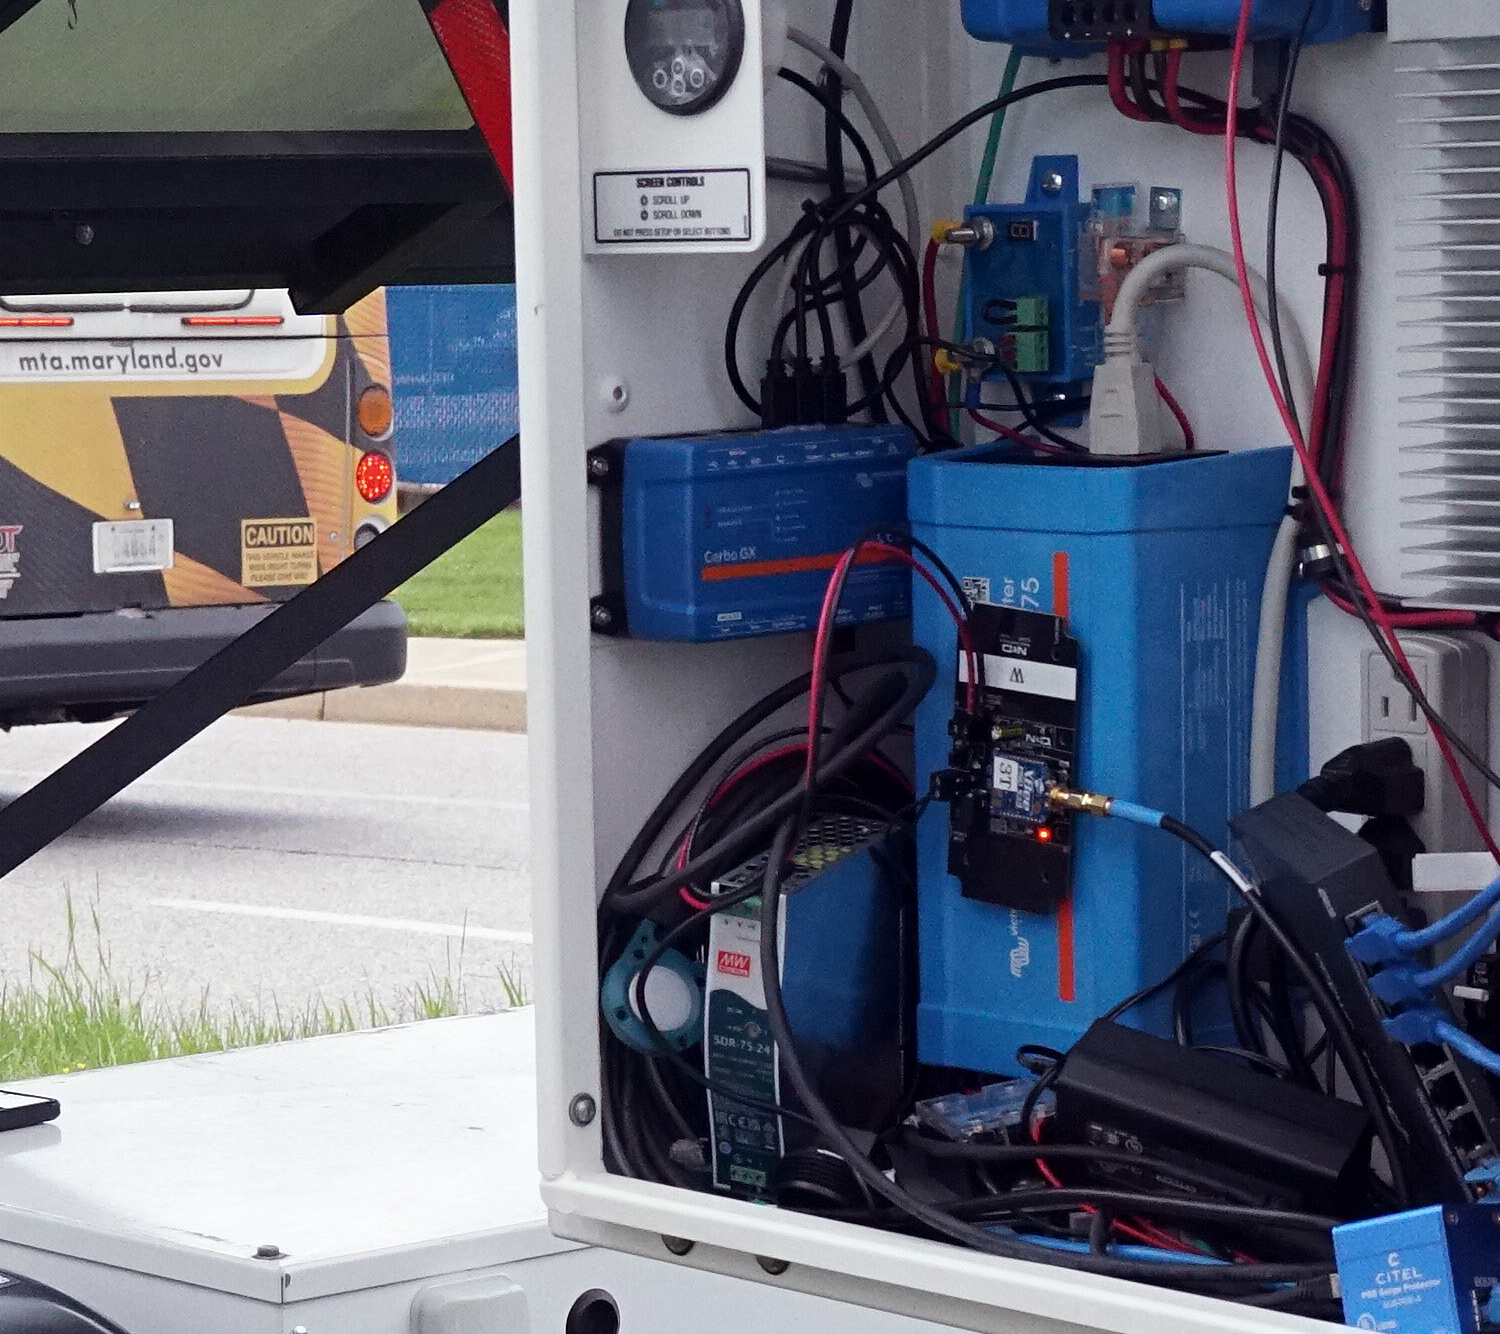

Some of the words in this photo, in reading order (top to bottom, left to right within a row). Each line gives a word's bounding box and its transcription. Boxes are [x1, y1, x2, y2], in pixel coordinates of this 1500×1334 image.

[636, 177, 664, 188] SCREEN
[667, 176, 704, 187] CONTROLS
[652, 195, 677, 205] SCROLL
[681, 195, 690, 204] UP
[652, 210, 677, 219] SCROLL
[681, 209, 702, 218] DOWN
[19, 346, 223, 375] mta.maryland.gov
[246, 525, 314, 546] CAUTION
[704, 549, 738, 563] Cerbo
[739, 546, 756, 560] GX
[1001, 577, 1014, 604] ter
[1021, 577, 1040, 608] 75
[719, 951, 750, 969] MW
[713, 1034, 771, 1055] SDR-75-24
[1375, 1267, 1422, 1285] CITEL
